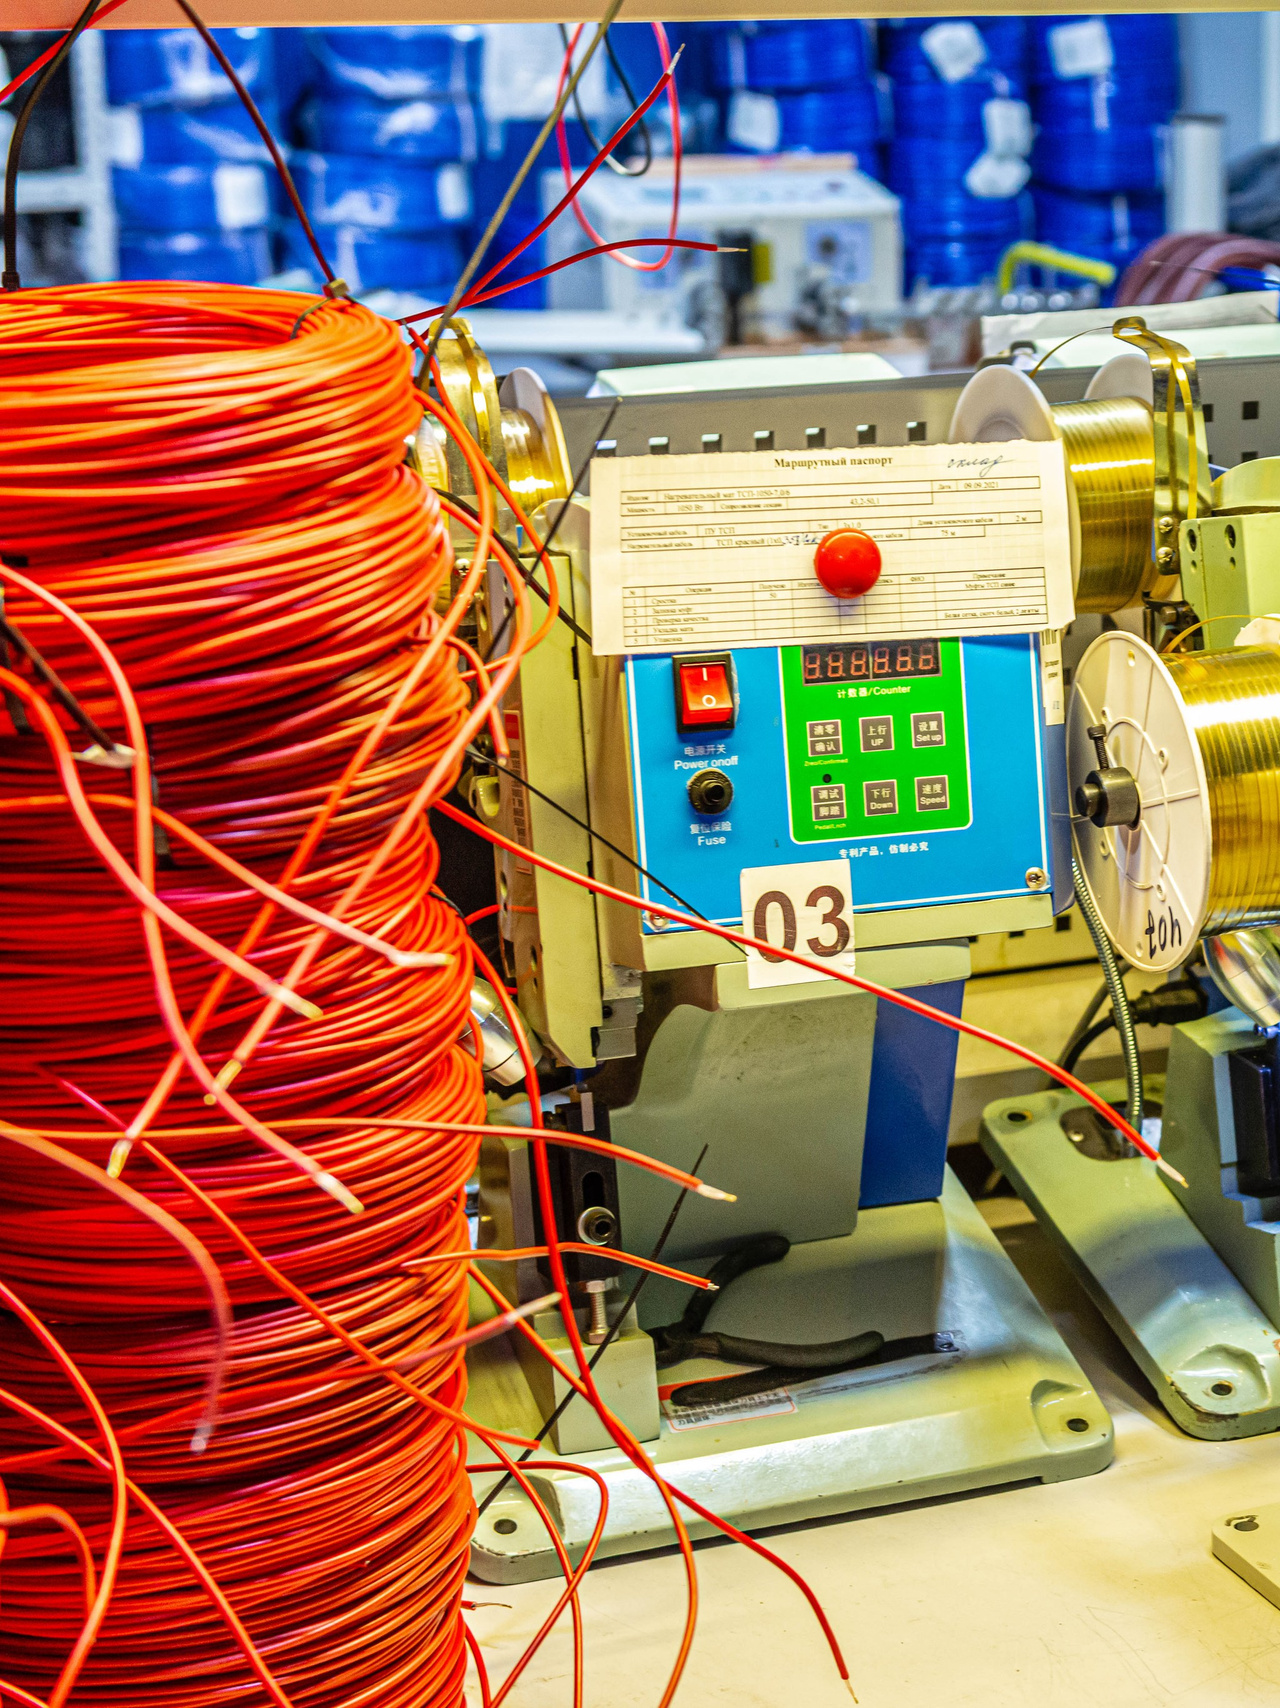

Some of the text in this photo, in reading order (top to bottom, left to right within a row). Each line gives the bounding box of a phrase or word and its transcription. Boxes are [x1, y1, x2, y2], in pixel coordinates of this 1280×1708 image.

[774, 456, 893, 469] Маршрутный паспорт
[867, 725, 888, 736] 上行
[918, 720, 939, 732] 设置
[870, 738, 884, 747] UP
[916, 734, 942, 742] Set up
[674, 756, 739, 771] Power onoff
[818, 789, 840, 800] 调试
[870, 788, 892, 799] 下行
[921, 783, 943, 795] 速度
[870, 802, 894, 810] Down
[920, 796, 946, 806] Speed
[697, 835, 727, 846] Fuse
[753, 885, 850, 963] 03
